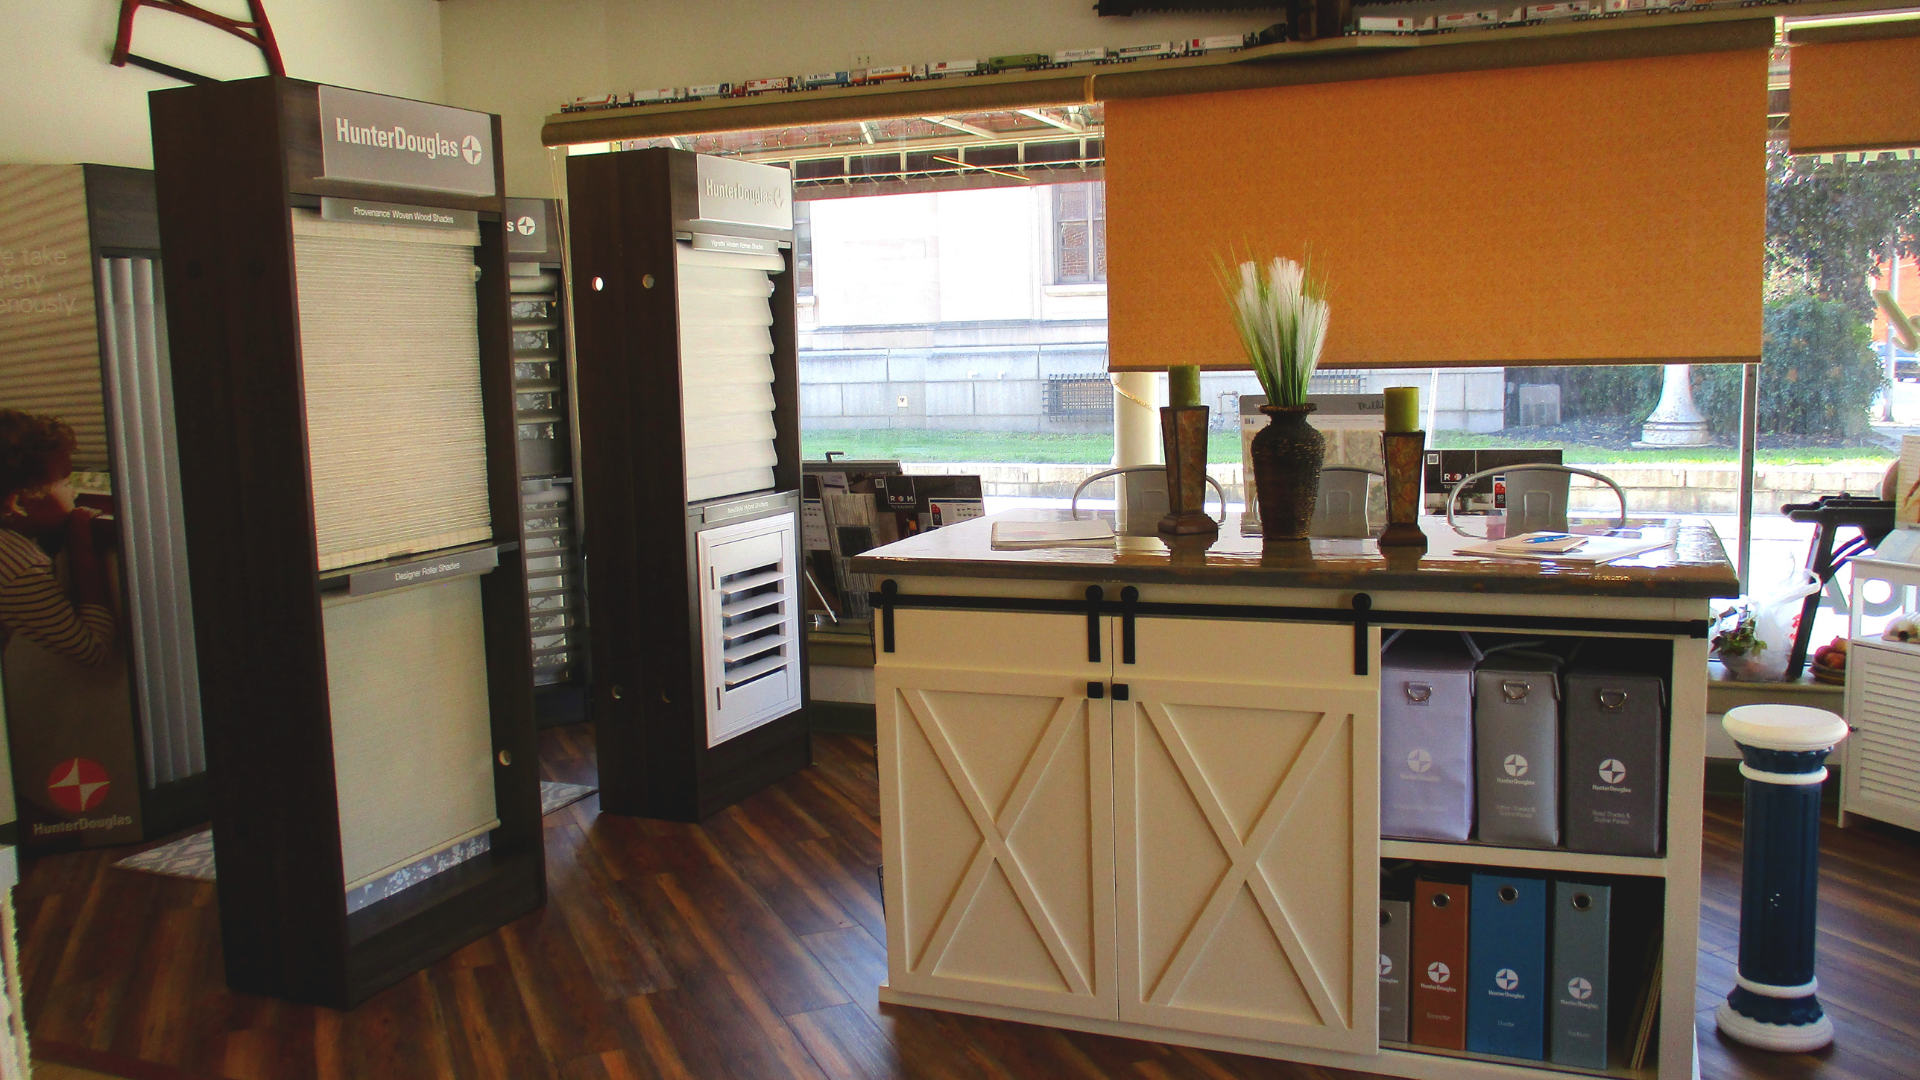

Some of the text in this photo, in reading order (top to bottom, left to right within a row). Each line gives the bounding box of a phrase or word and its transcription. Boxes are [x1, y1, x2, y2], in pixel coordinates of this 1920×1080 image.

[336, 117, 459, 161] HunterDouglas
[705, 178, 773, 206] HunterDouglas
[392, 210, 414, 221] Woven
[414, 212, 432, 222] Wood
[432, 213, 455, 224] Shades
[395, 562, 460, 581] Designer Roller Shades
[33, 814, 133, 835] HunterDouglas
